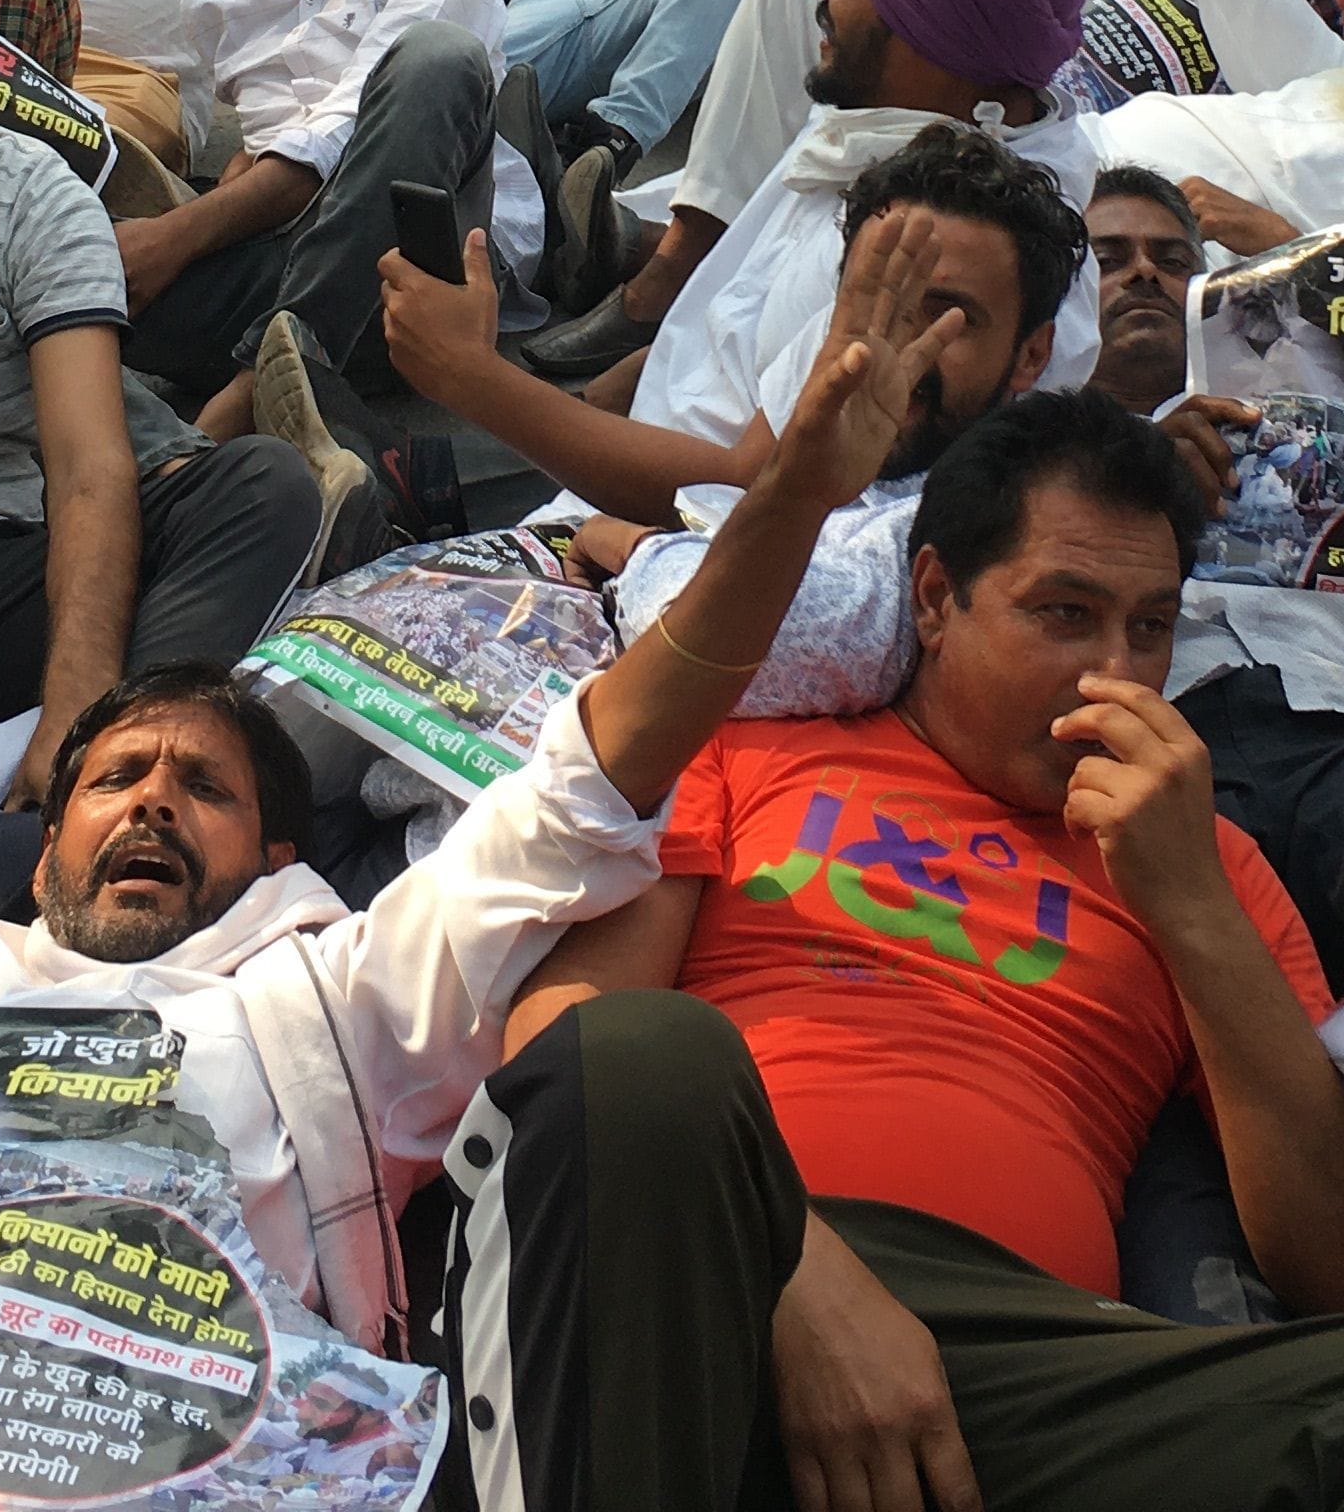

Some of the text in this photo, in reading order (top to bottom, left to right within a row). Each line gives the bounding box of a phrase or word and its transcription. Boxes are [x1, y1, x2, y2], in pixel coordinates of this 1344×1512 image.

[15, 94, 103, 150] चलवाता
[297, 645, 358, 692] किसान
[354, 684, 419, 727] यूनियन
[351, 631, 390, 661] हक
[384, 649, 438, 690] लेकर
[21, 1029, 145, 1066] जो खुद
[6, 1063, 173, 1106] किसानों
[112, 1243, 158, 1279] को
[157, 1257, 231, 1308] मारी
[33, 1259, 70, 1288] का
[71, 1270, 146, 1316] हिसाब
[148, 1294, 193, 1333] देना
[193, 1316, 255, 1353] होगा,
[47, 1312, 83, 1340] का
[86, 1327, 186, 1369] पर्दाफाश
[188, 1357, 250, 1390] होगा,
[11, 1350, 41, 1380] के
[43, 1363, 92, 1392] खून
[93, 1374, 130, 1401] की
[132, 1389, 166, 1411] हर
[169, 1398, 213, 1431] बूंद,
[22, 1388, 58, 1413] रंग
[61, 1398, 146, 1440] लाएगी,
[5, 1417, 105, 1455] सरकारों
[105, 1439, 143, 1465] को
